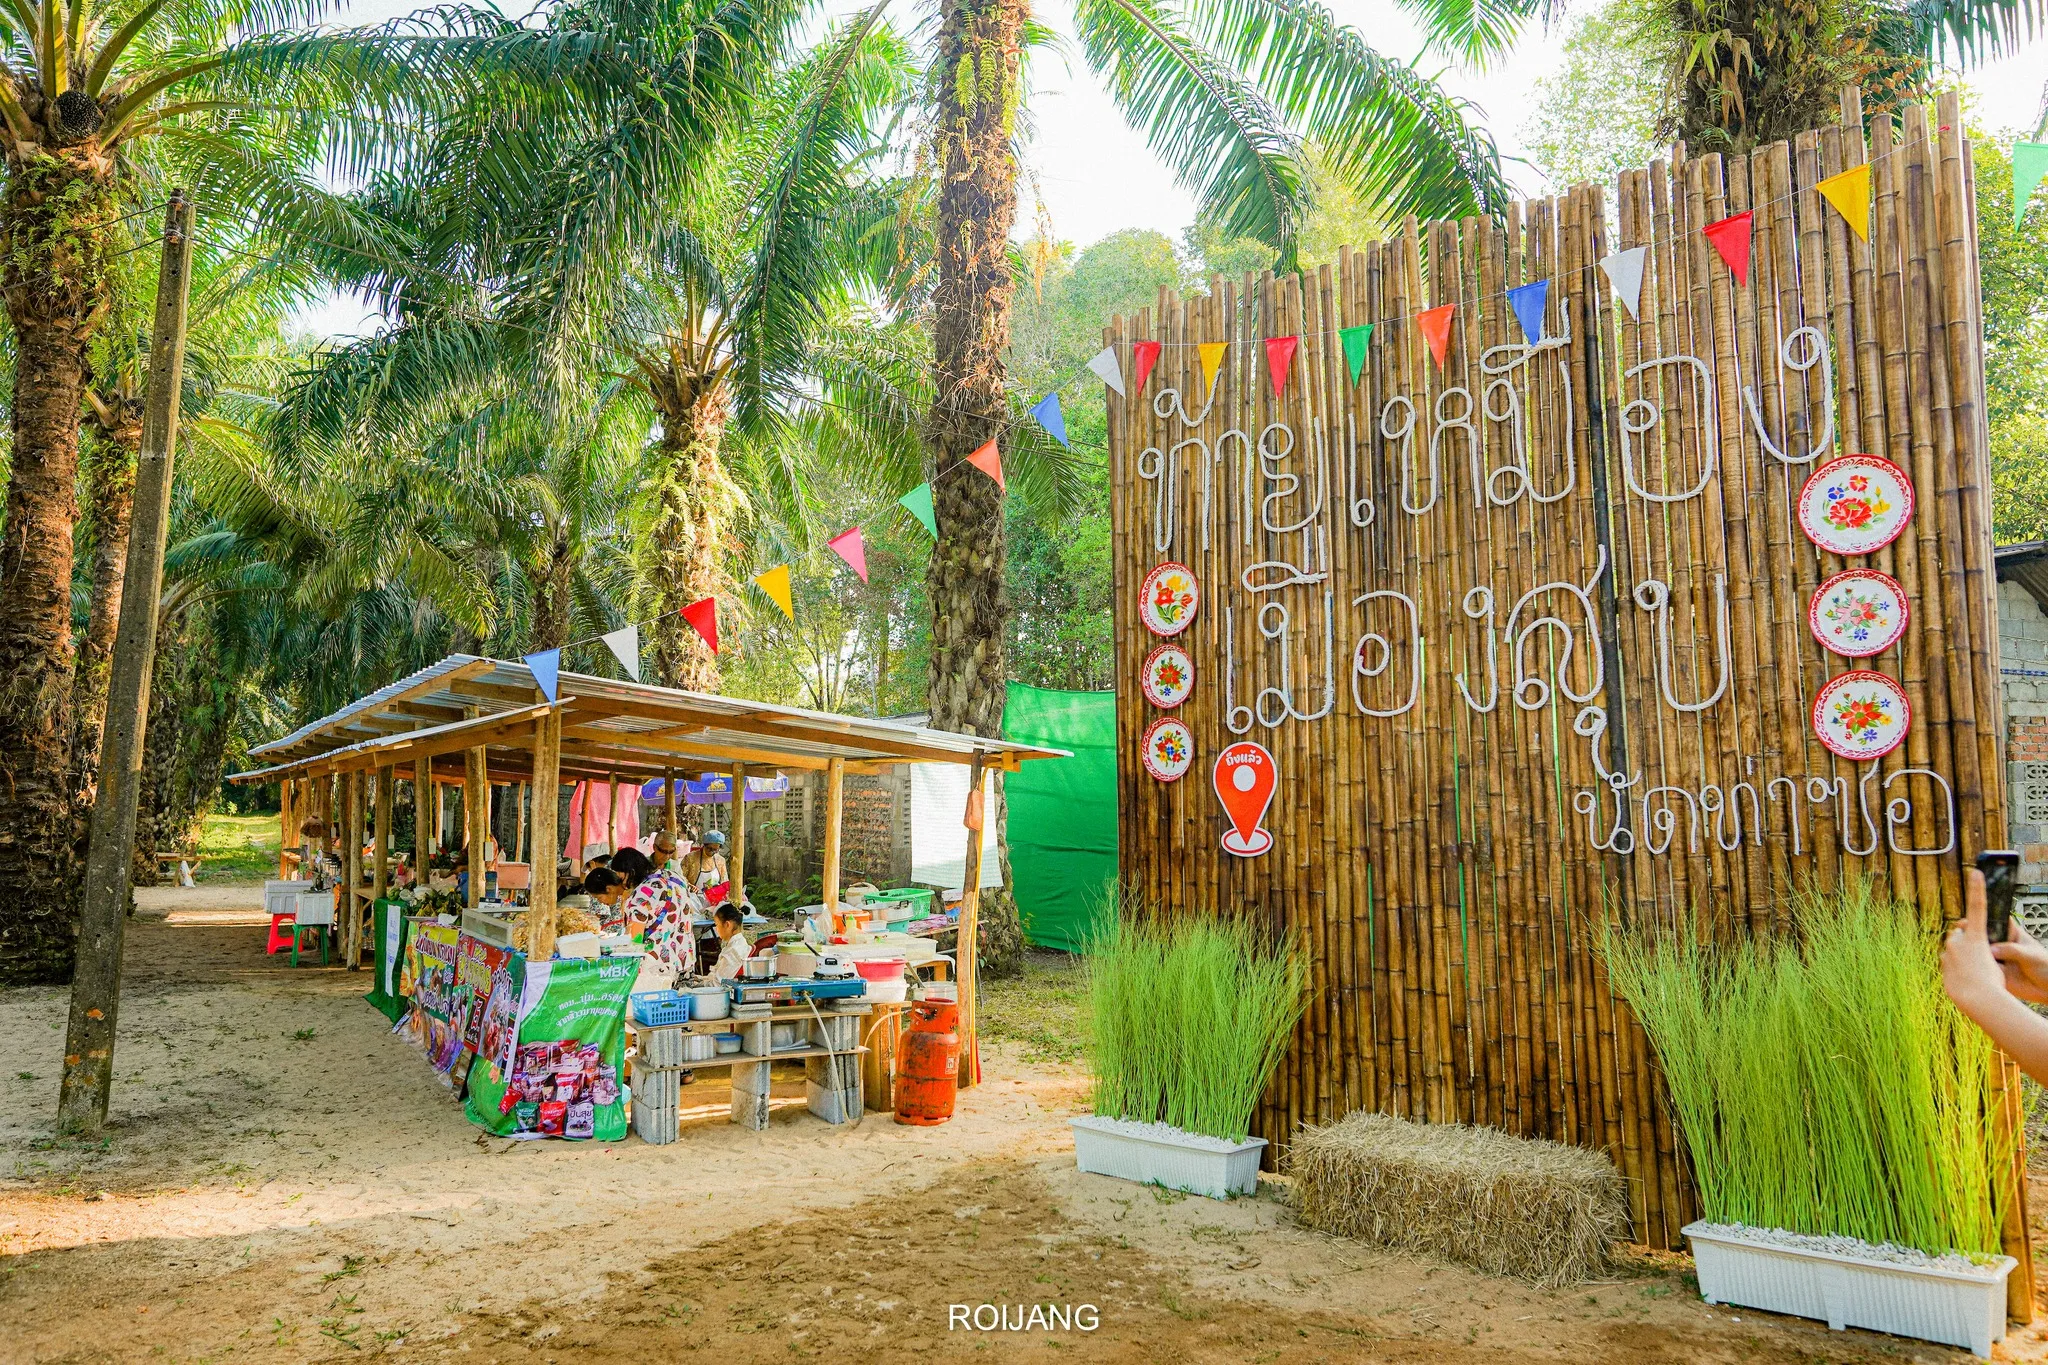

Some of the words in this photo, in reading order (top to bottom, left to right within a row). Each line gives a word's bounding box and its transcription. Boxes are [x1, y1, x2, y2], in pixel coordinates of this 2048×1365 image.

[1137, 297, 1834, 552] ท้ายเหมือง
[1226, 749, 1263, 766] ถึงแล้ว
[599, 967, 632, 979] MBK
